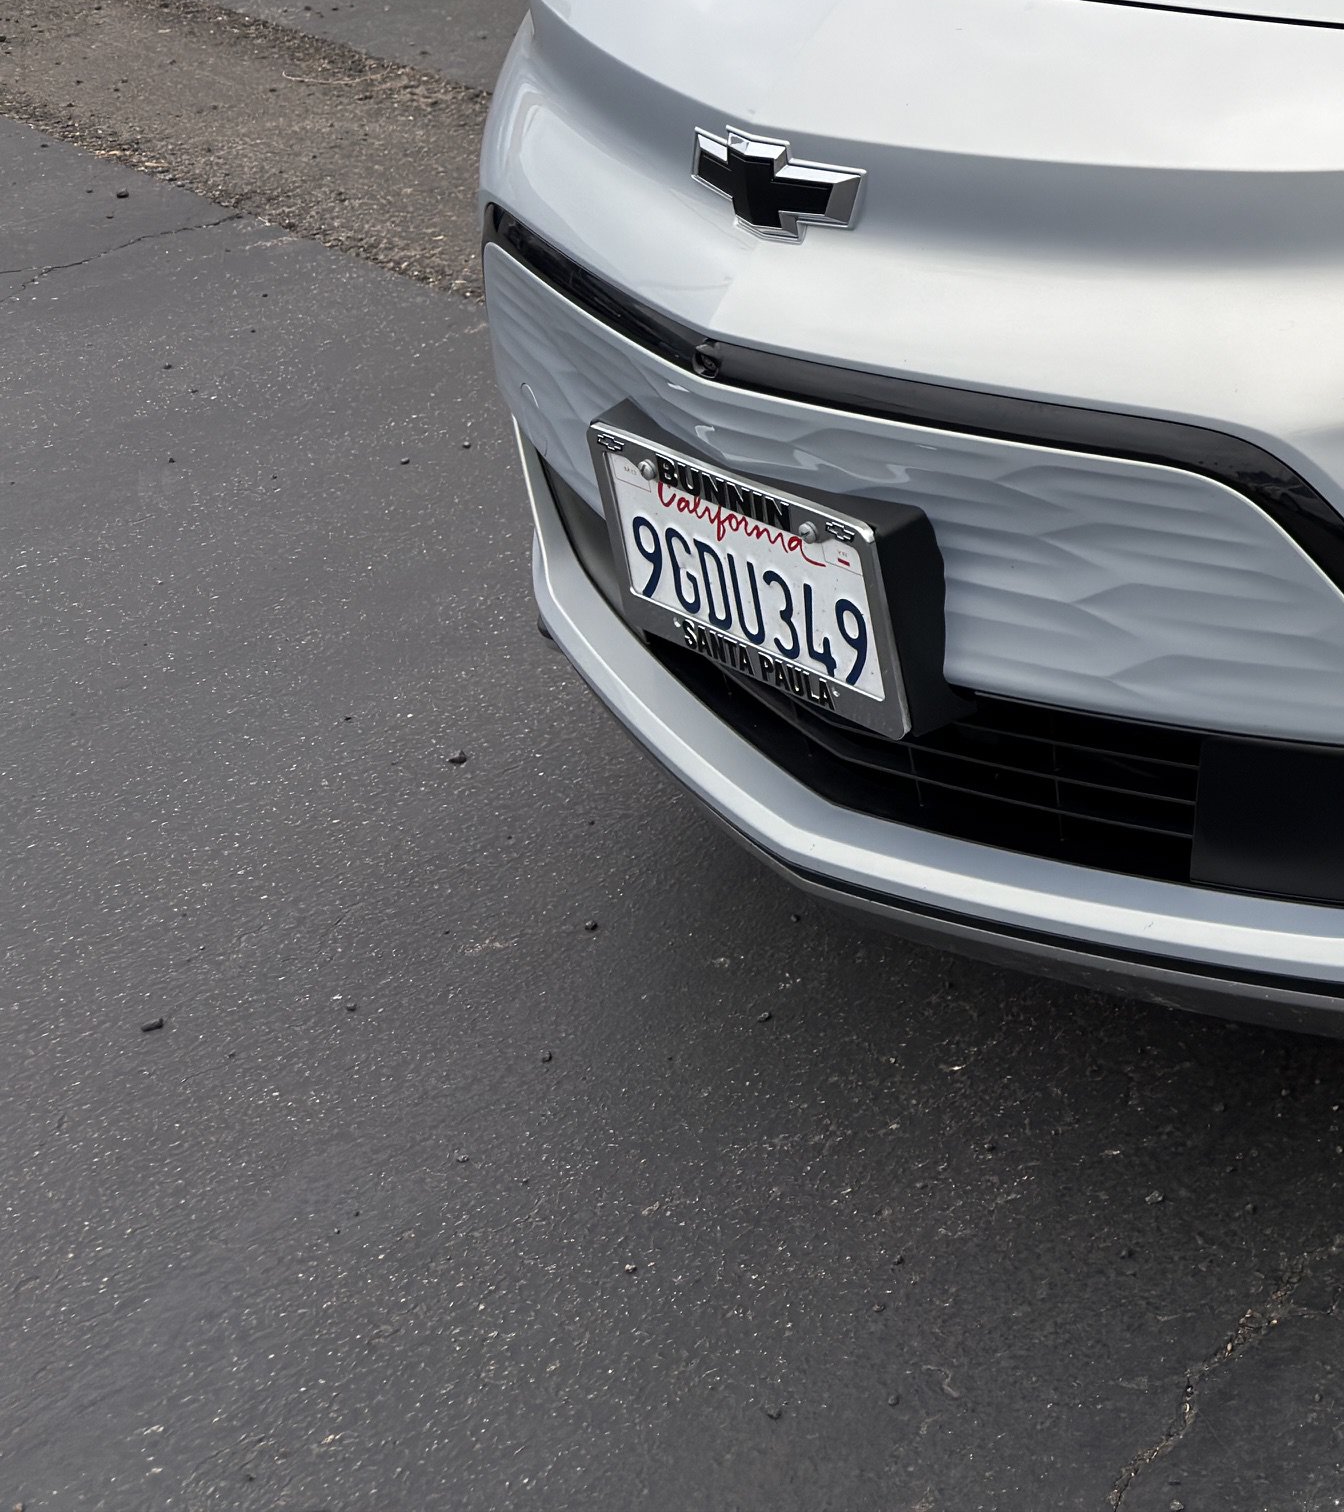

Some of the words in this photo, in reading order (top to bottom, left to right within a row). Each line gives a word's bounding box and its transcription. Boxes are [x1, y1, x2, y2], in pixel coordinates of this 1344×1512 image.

[655, 453, 791, 532] BUNNIN
[657, 481, 826, 568] California
[632, 515, 868, 686] 9GDU349
[681, 618, 755, 677] SANTA
[757, 651, 836, 711] PAULA
